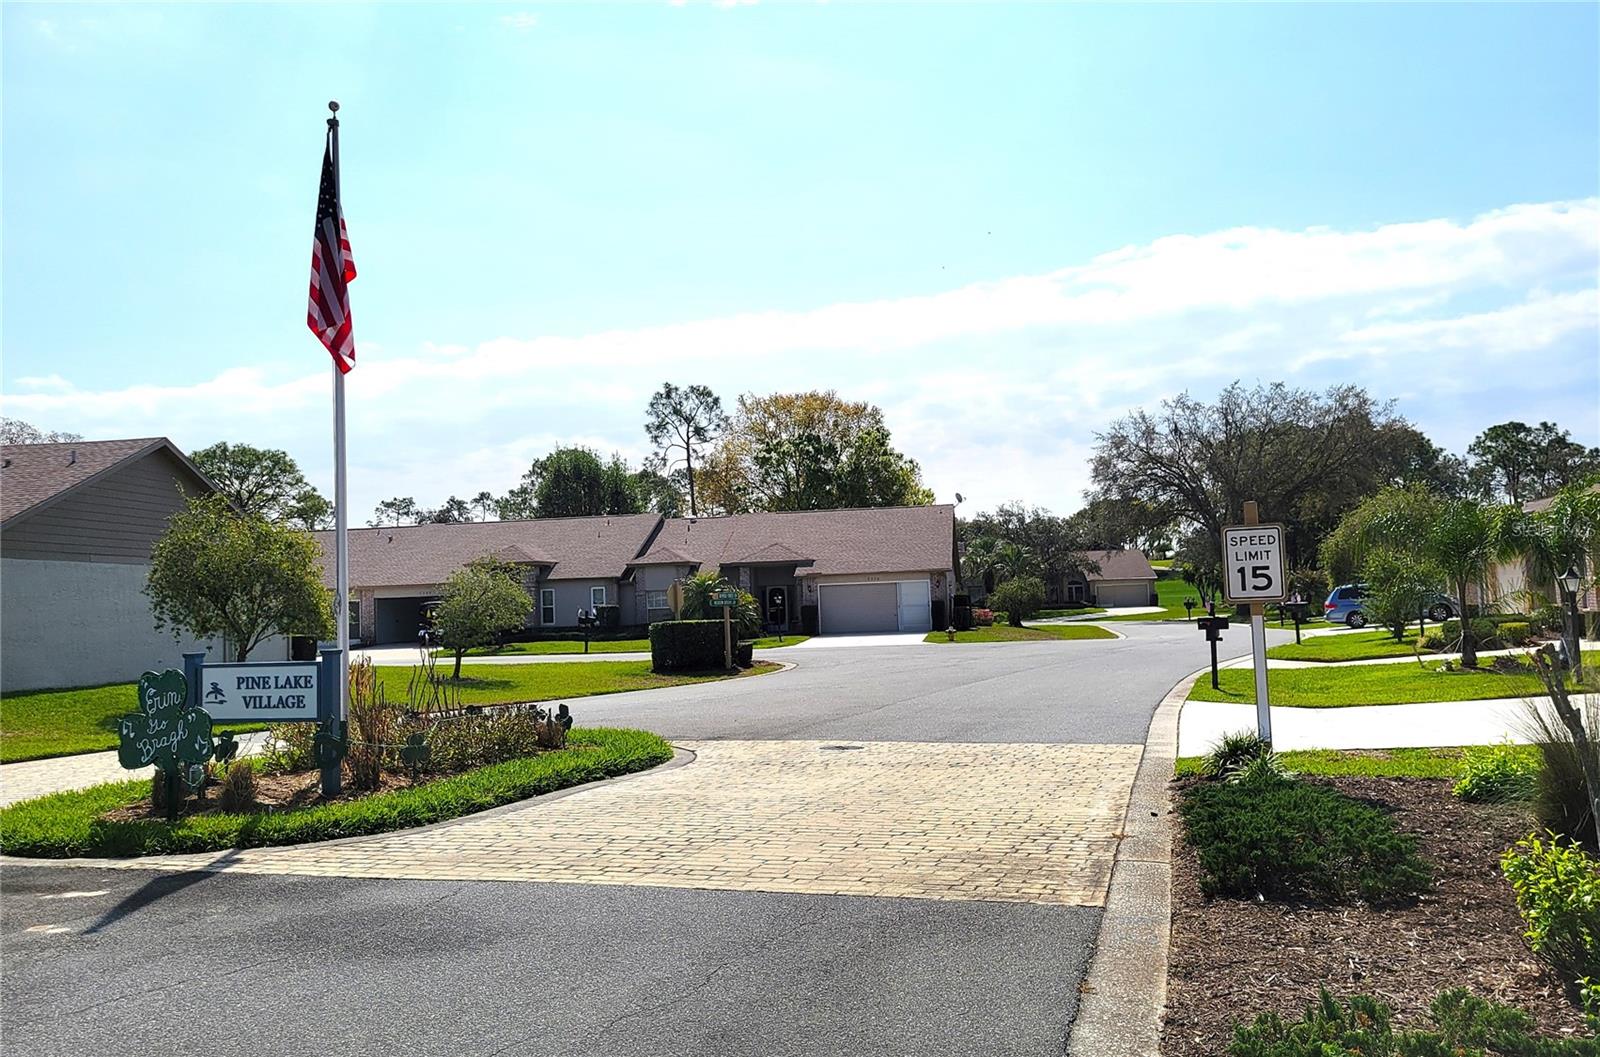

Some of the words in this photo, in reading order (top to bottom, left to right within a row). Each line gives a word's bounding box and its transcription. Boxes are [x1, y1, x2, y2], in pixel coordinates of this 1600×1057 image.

[1230, 535, 1276, 546] SPEED
[1235, 550, 1271, 561] LIMIT
[1237, 565, 1273, 592] 15
[236, 676, 271, 690] PINE
[274, 675, 314, 689] LAKE
[242, 695, 306, 709] VILLAGE
[147, 720, 168, 735] Go
